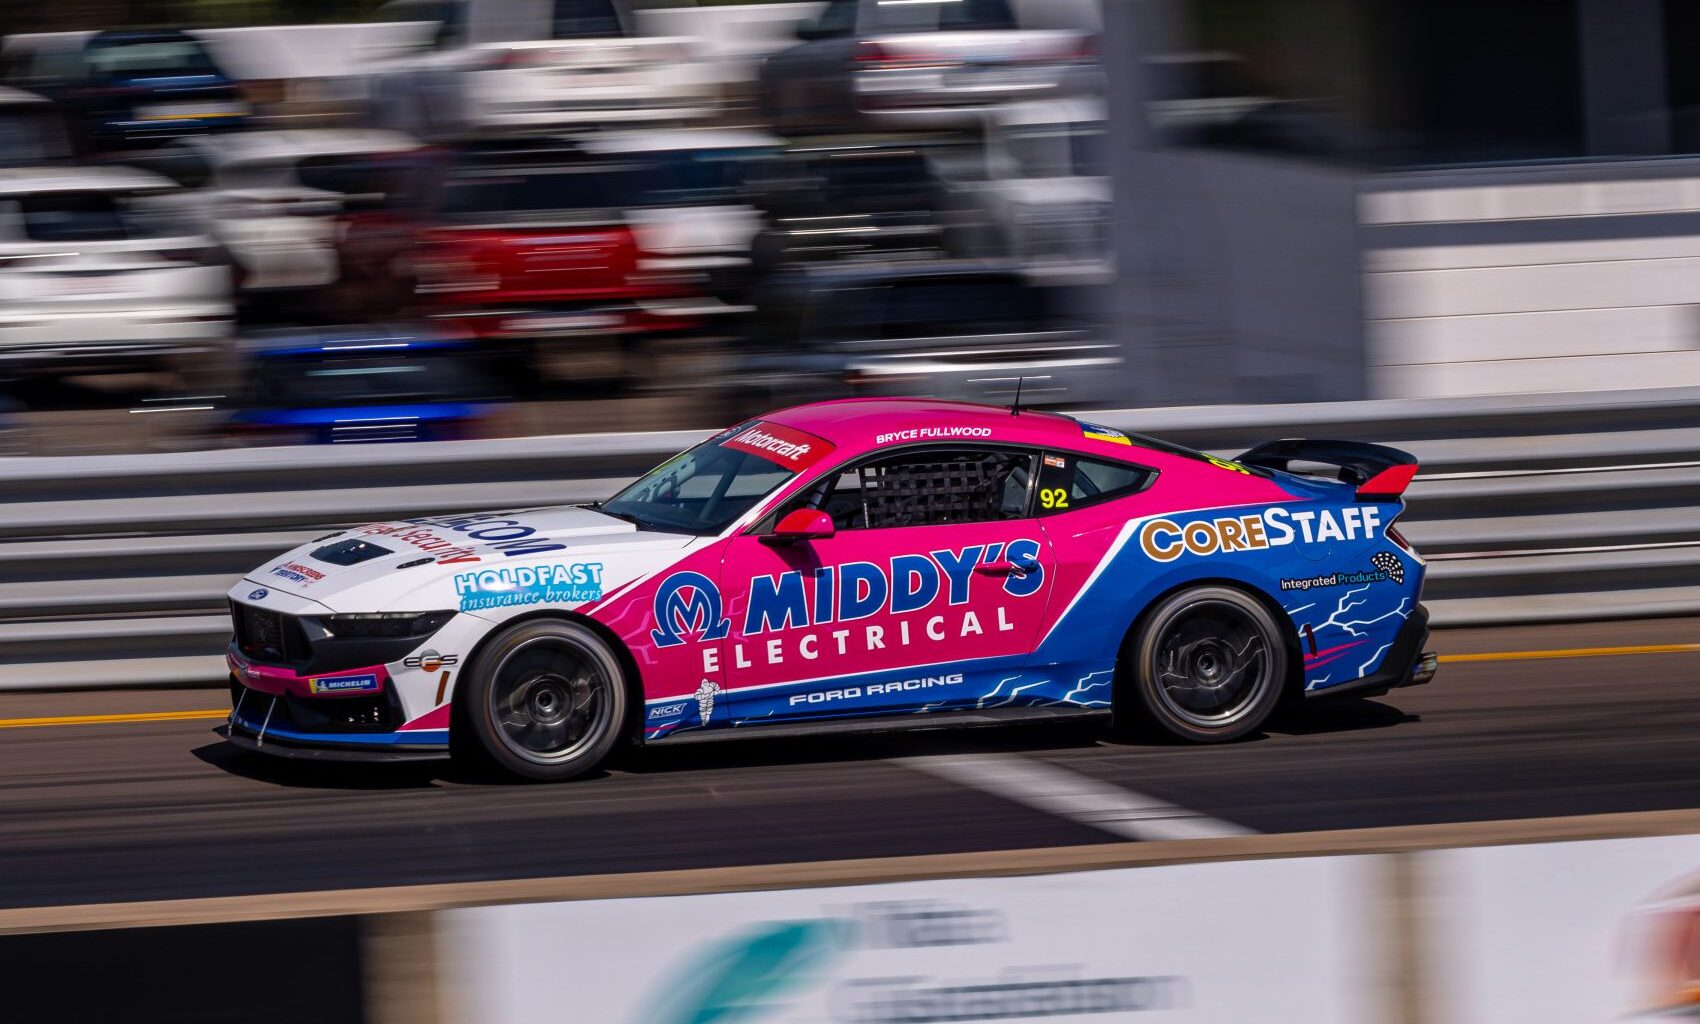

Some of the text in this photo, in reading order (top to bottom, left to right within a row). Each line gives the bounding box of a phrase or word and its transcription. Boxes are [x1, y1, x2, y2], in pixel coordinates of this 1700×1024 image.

[735, 429, 812, 461] Motorcraft
[876, 426, 992, 444] BRYCE FULLWOOD
[1040, 488, 1069, 509] 92
[456, 563, 602, 594] HOLDFAST
[743, 538, 1045, 636] MIDDY'S
[1281, 571, 1386, 589] Integrated Products
[461, 585, 602, 611] insurance brokers
[703, 606, 1014, 673] ELECTRICAL
[328, 679, 371, 688] MICHELIN
[789, 673, 964, 706] FORD RACING
[650, 705, 682, 717] NICK
